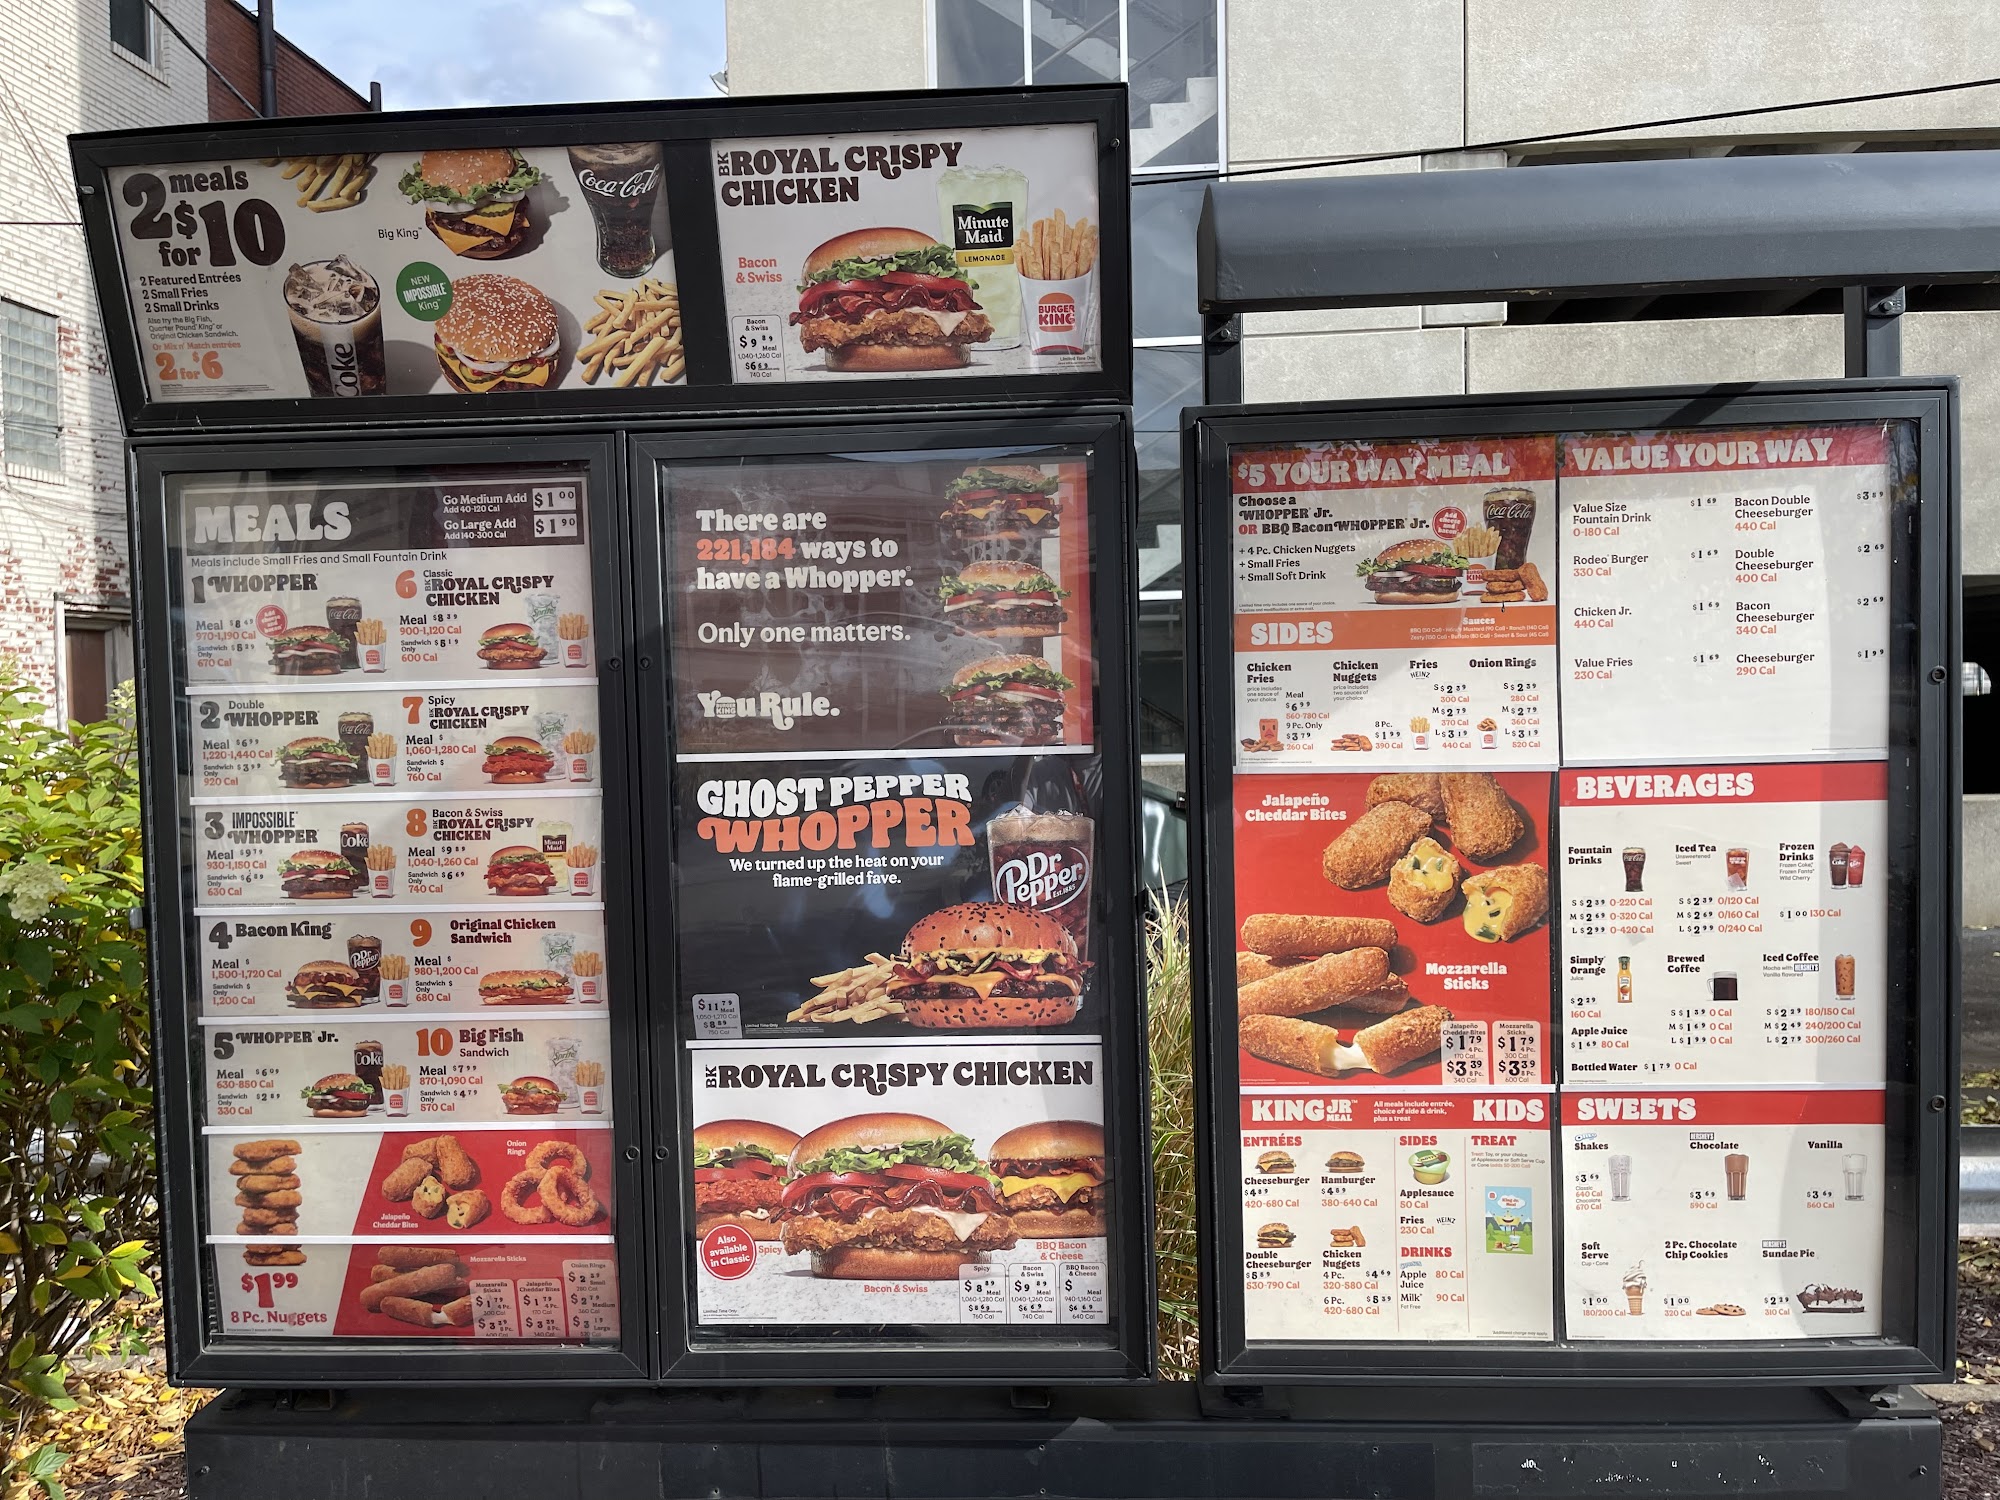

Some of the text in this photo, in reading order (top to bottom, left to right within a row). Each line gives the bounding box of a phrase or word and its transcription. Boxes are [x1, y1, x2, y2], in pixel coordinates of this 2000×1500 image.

[717, 151, 730, 176] BK
[730, 147, 839, 176] ROYAL
[721, 176, 859, 207] CHICKEN
[122, 165, 248, 240] 2 meals
[958, 216, 1009, 230] Minute
[965, 229, 1003, 244] Maid
[158, 241, 201, 267] for
[964, 254, 1005, 262] LEMONADE
[738, 257, 777, 268] Bacon
[140, 272, 241, 286] 2 Featured Entrées
[411, 275, 430, 286] NEW
[736, 271, 782, 284] & Swiss
[142, 287, 208, 299] 2 Small Fries
[144, 300, 219, 313] 2 Small Drinks
[1038, 303, 1075, 313] BURGER
[1039, 313, 1075, 325] KING
[150, 333, 176, 341] Original
[204, 330, 238, 338] Sandwich.
[1572, 438, 1833, 471] VALUE YOUR WAY
[1270, 462, 1351, 486] YOUR
[1356, 457, 1422, 482] WAY
[1426, 452, 1510, 480] MEAL
[443, 493, 527, 505] Go Medium Add
[1238, 495, 1296, 507] Choose a
[460, 505, 486, 513] 40-120
[1573, 502, 1627, 513] Value Size
[1735, 508, 1813, 518] Cheeseburger
[194, 502, 351, 544] MEALS
[696, 509, 826, 531] There are
[1573, 513, 1651, 524] Fountain Drink
[697, 538, 898, 565] 221,184 ways to
[1735, 548, 1774, 559] Double
[191, 551, 447, 567] Meals include Small Fries and Small Fountain Drink
[697, 567, 760, 589] have
[765, 568, 780, 589] a
[1573, 567, 1611, 577] 330 Cal
[1574, 606, 1632, 617] Chicken Jr.
[1736, 602, 1770, 611] Bacon
[400, 625, 462, 636] 900-1,120 Cal
[698, 622, 911, 648] Only one matters.
[1251, 621, 1333, 645] SIDES
[1247, 662, 1291, 672] Chicken
[1469, 657, 1536, 669] Onion Rings
[1247, 674, 1274, 683] Fries
[760, 692, 840, 730] Rule.
[203, 750, 273, 761] 1,220-1,440 Cal
[1577, 773, 1754, 799] BEVERAGES
[697, 774, 972, 818] GHOST PEPPER
[1262, 793, 1329, 809] Jalapeño
[1245, 807, 1347, 821] Cheddar Bites
[406, 808, 503, 837] 8 Bacon & Swiss
[1568, 845, 1612, 854] Fountain
[1676, 844, 1716, 852] Iced Tea
[729, 855, 944, 872] We turned up the heat on your
[1568, 856, 1602, 864] Drinks
[773, 871, 901, 889] flame-grilled fave.
[410, 918, 556, 947] 9 Original Chicken
[451, 932, 512, 943] Sandwich
[1667, 954, 1704, 962] Brewed
[1426, 962, 1507, 975] Mozzarella
[1668, 964, 1700, 973] Coffee
[1444, 976, 1489, 990] Sticks
[416, 1027, 524, 1056] 10 Big Fish
[1572, 1063, 1638, 1071] Bottled Water
[705, 1066, 717, 1088] BK
[718, 1064, 826, 1088] ROYAL
[953, 1061, 1093, 1086] CHICKEN
[1252, 1099, 1544, 1122] KING KIDS
[1578, 1098, 1696, 1120] SWEETS
[1243, 1133, 1302, 1147] ENTRÉES
[1471, 1135, 1517, 1146] TREAT
[1575, 1142, 1608, 1150] Shakes
[1808, 1140, 1843, 1149] Vanilla
[507, 1148, 526, 1156] Rings
[1244, 1176, 1310, 1186] Cheeseburger
[1321, 1176, 1376, 1186] Hamburger
[1400, 1189, 1454, 1199] Applesauce
[717, 1235, 736, 1245] Also
[1036, 1241, 1053, 1249] BBQ
[710, 1244, 747, 1256] available
[1040, 1252, 1083, 1260] & Cheese
[1401, 1247, 1452, 1257] DRINKS
[1665, 1250, 1728, 1260] Chip Cookies
[1763, 1249, 1815, 1258] Sundae Pie
[710, 1254, 750, 1267] in Classic
[231, 1311, 327, 1326] 8 Pc. Nuggets
